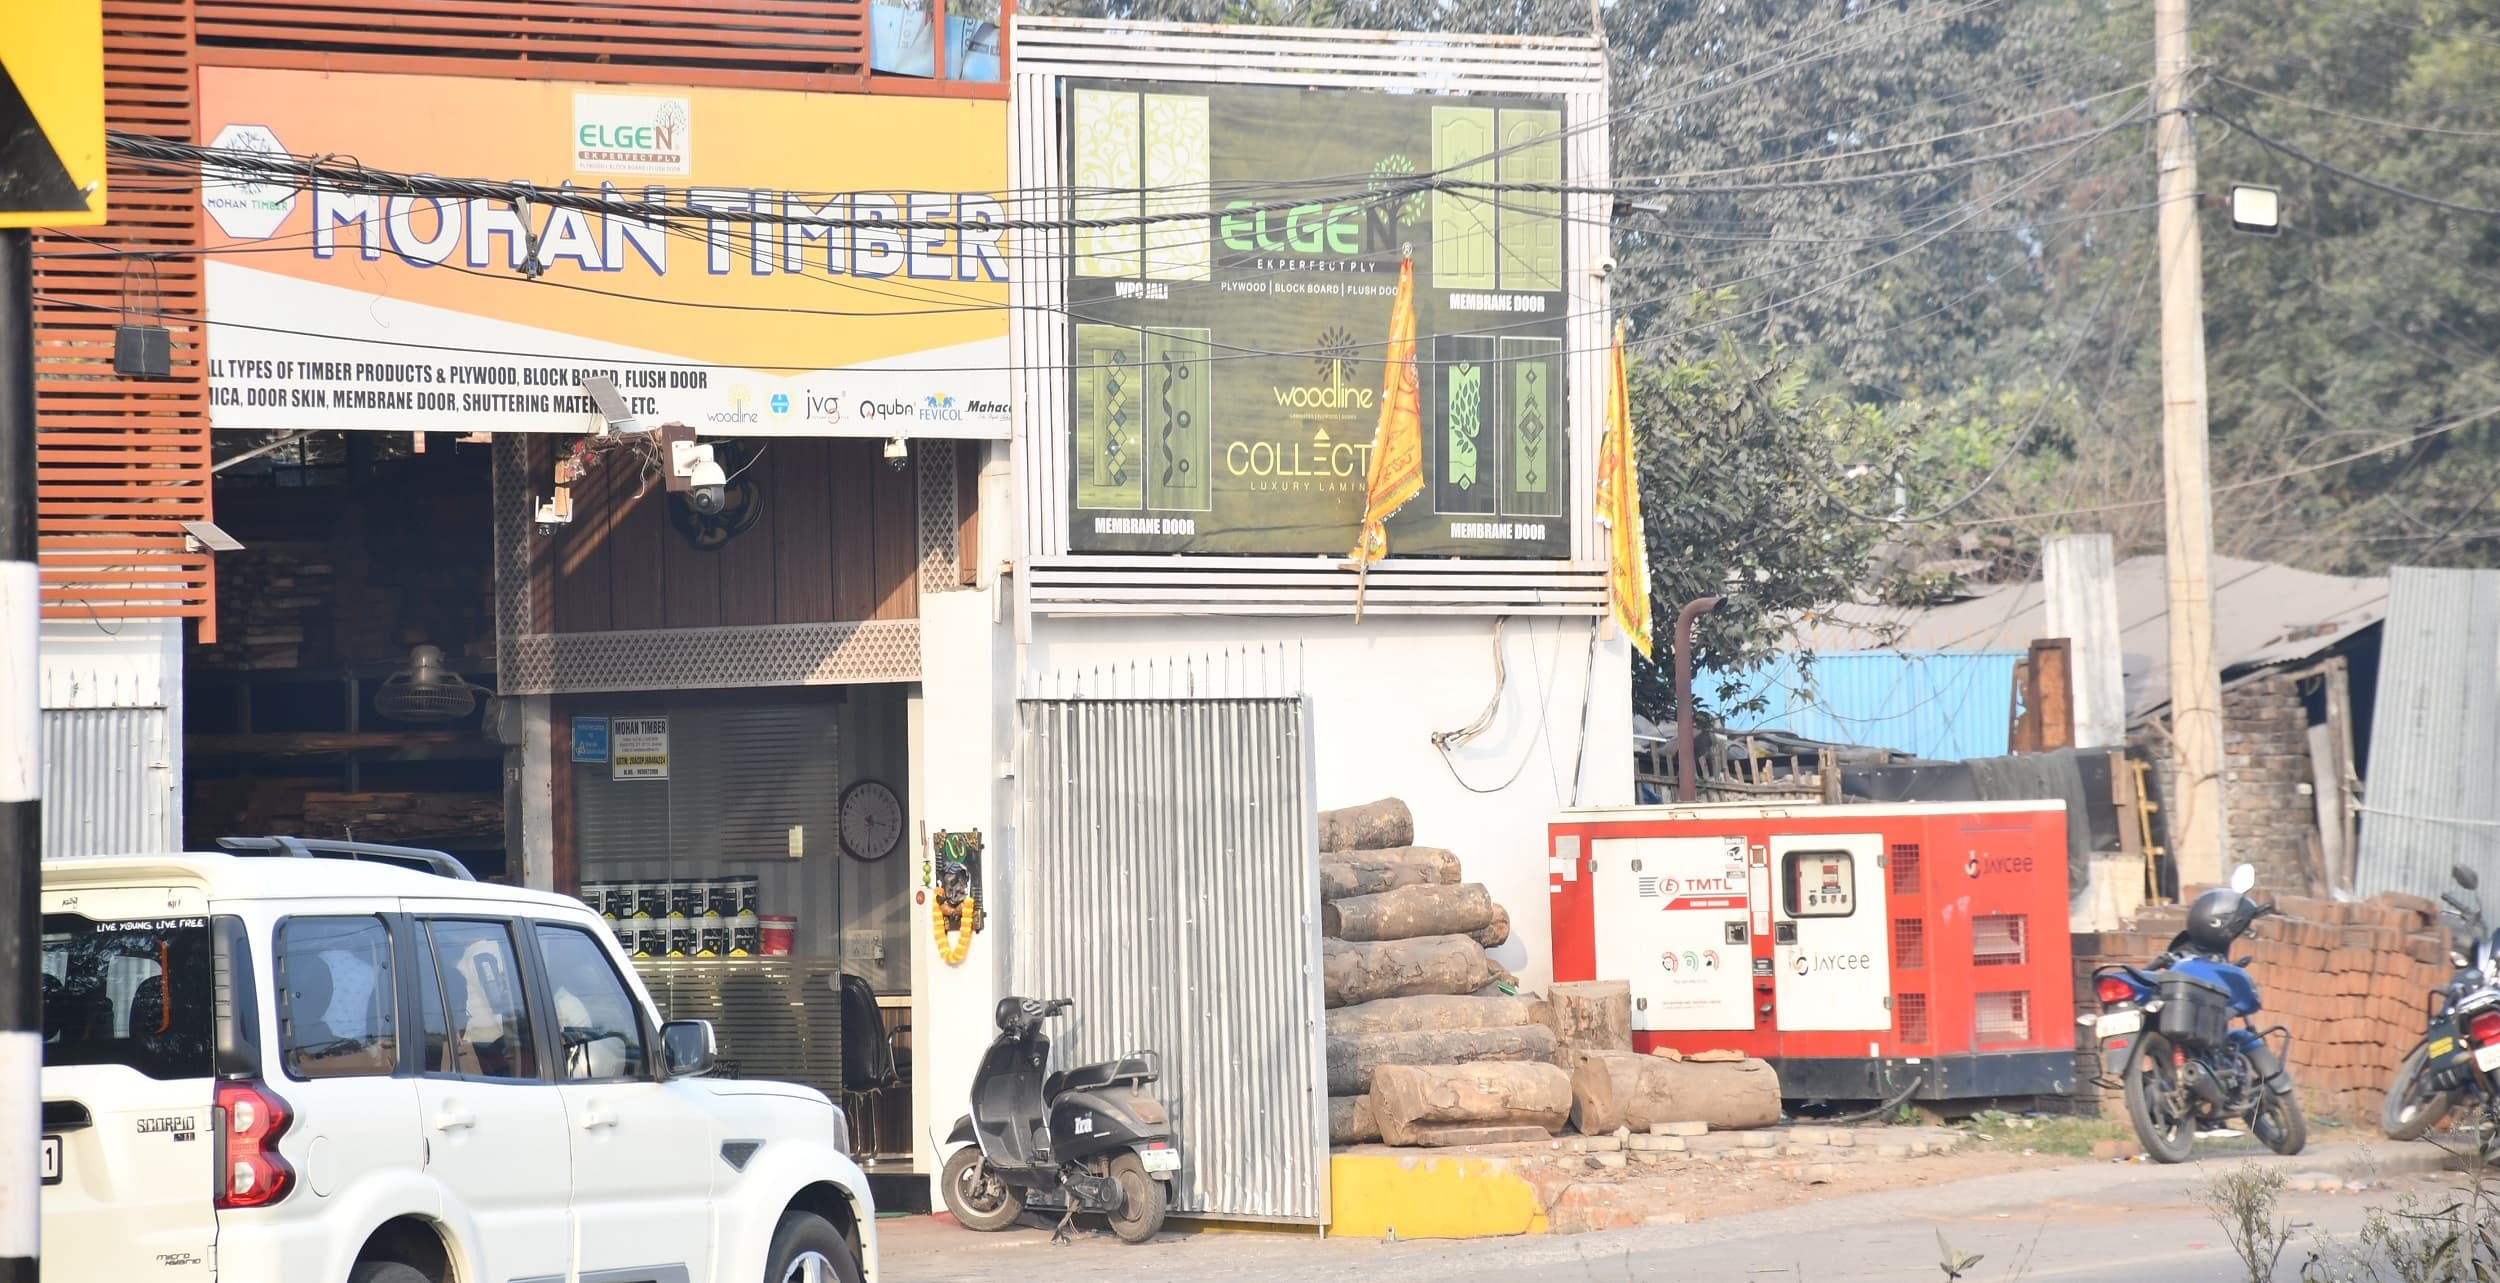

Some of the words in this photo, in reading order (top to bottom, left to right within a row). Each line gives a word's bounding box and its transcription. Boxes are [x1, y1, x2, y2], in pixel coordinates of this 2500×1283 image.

[580, 124, 672, 150] ELGEN
[207, 198, 248, 209] MOHAN
[312, 174, 666, 277] MOHAN
[687, 185, 1009, 282] TIMBER
[1220, 201, 1399, 255] ELGEN
[1221, 281, 1267, 292] PLYWOOD
[1274, 283, 1306, 294] BLOCK
[1307, 284, 1340, 295] BOARD
[1347, 285, 1377, 296] FLUSH
[1449, 293, 1513, 312] MEMBRANE
[1513, 295, 1545, 313] DOOR
[207, 359, 225, 378] LL
[228, 359, 272, 380] TYPES
[277, 361, 295, 380] OF
[298, 361, 352, 382] TIMBER
[356, 363, 433, 383] PRODUCTS
[436, 368, 446, 383] &
[450, 365, 520, 388] PLYWOOD,
[523, 368, 568, 387] BLOCK
[625, 370, 667, 388] FLUSH
[670, 371, 708, 389] DOOR
[1274, 367, 1373, 409] woodline
[247, 388, 287, 407] DOOR
[292, 389, 330, 409] SKIN,
[333, 389, 413, 410] MEMBRANE
[417, 392, 460, 412] DOOR,
[463, 392, 549, 413] SHUTTERING
[631, 396, 660, 415] ETC.
[706, 402, 758, 424] woodline
[919, 409, 964, 421] FEVICOL
[1250, 481, 1311, 492] LUXURY
[1094, 517, 1161, 535] MEMBRANE
[1162, 518, 1195, 536] DOOR
[1450, 522, 1513, 539] MEMBRANE
[1514, 523, 1546, 540] DOOR
[615, 720, 639, 735] MOHAN
[640, 720, 666, 734] TIMBER
[1685, 878, 1733, 891] TMTL
[97, 922, 117, 933] LIVE
[156, 919, 177, 929] LIVE
[179, 918, 205, 928] FREE
[137, 1116, 195, 1133] SCORPIO
